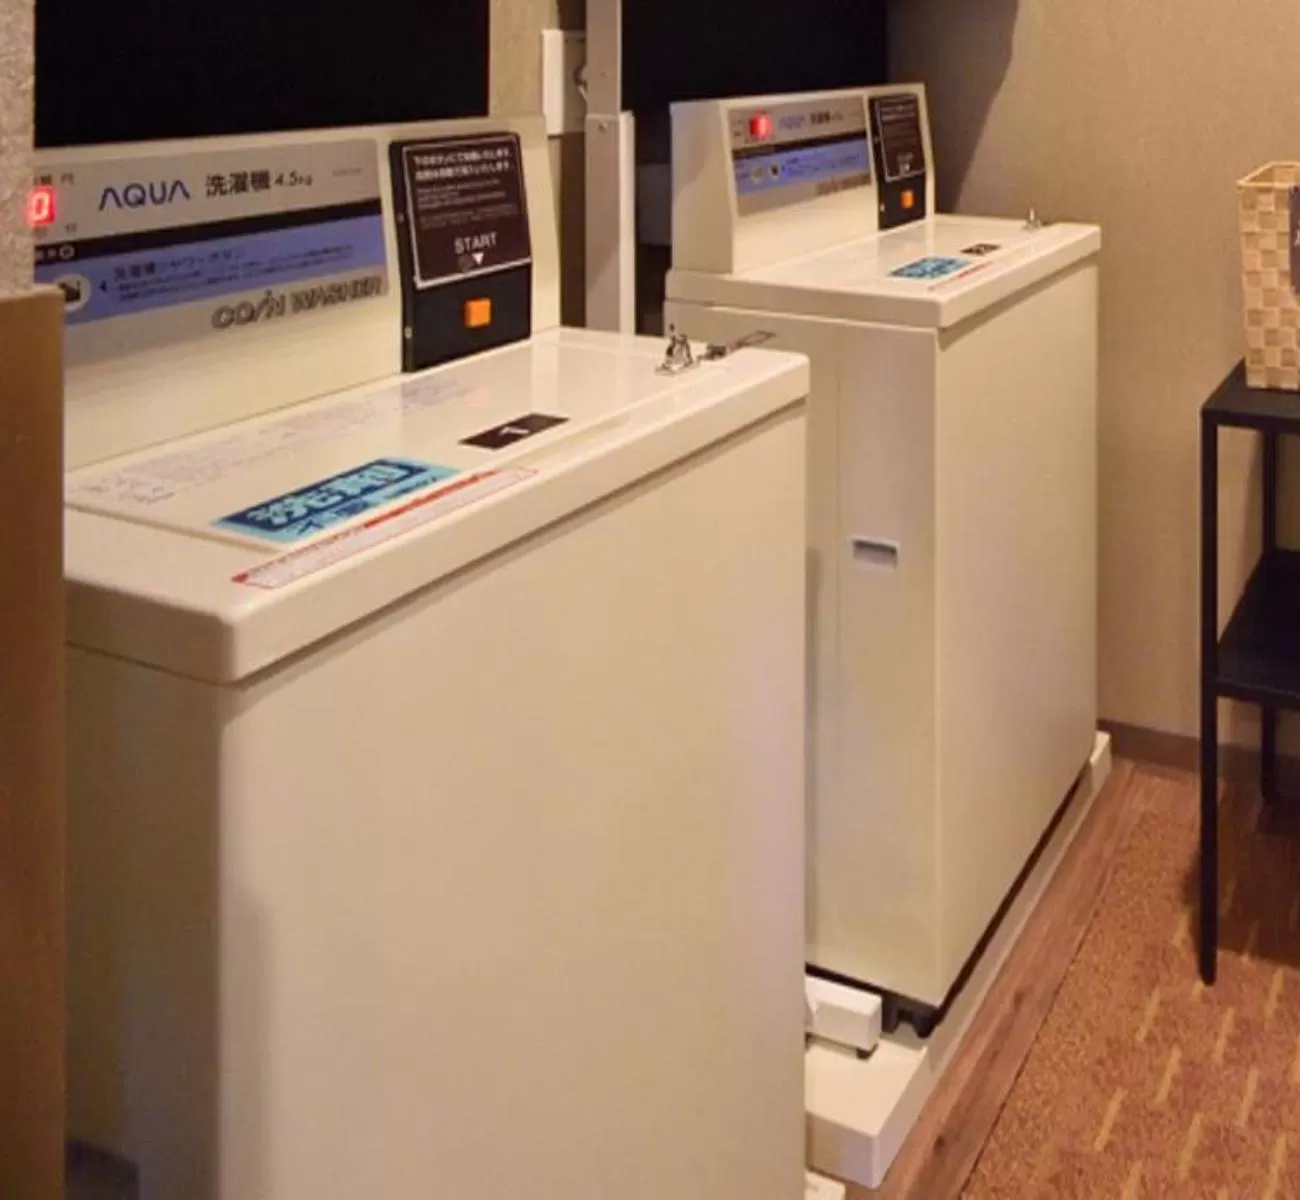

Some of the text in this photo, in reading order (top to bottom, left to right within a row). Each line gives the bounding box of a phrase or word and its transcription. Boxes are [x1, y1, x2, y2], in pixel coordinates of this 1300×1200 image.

[30, 190, 50, 221] 0
[98, 179, 192, 212] AQUA
[204, 169, 271, 198] 洗濯機
[454, 231, 498, 255] START
